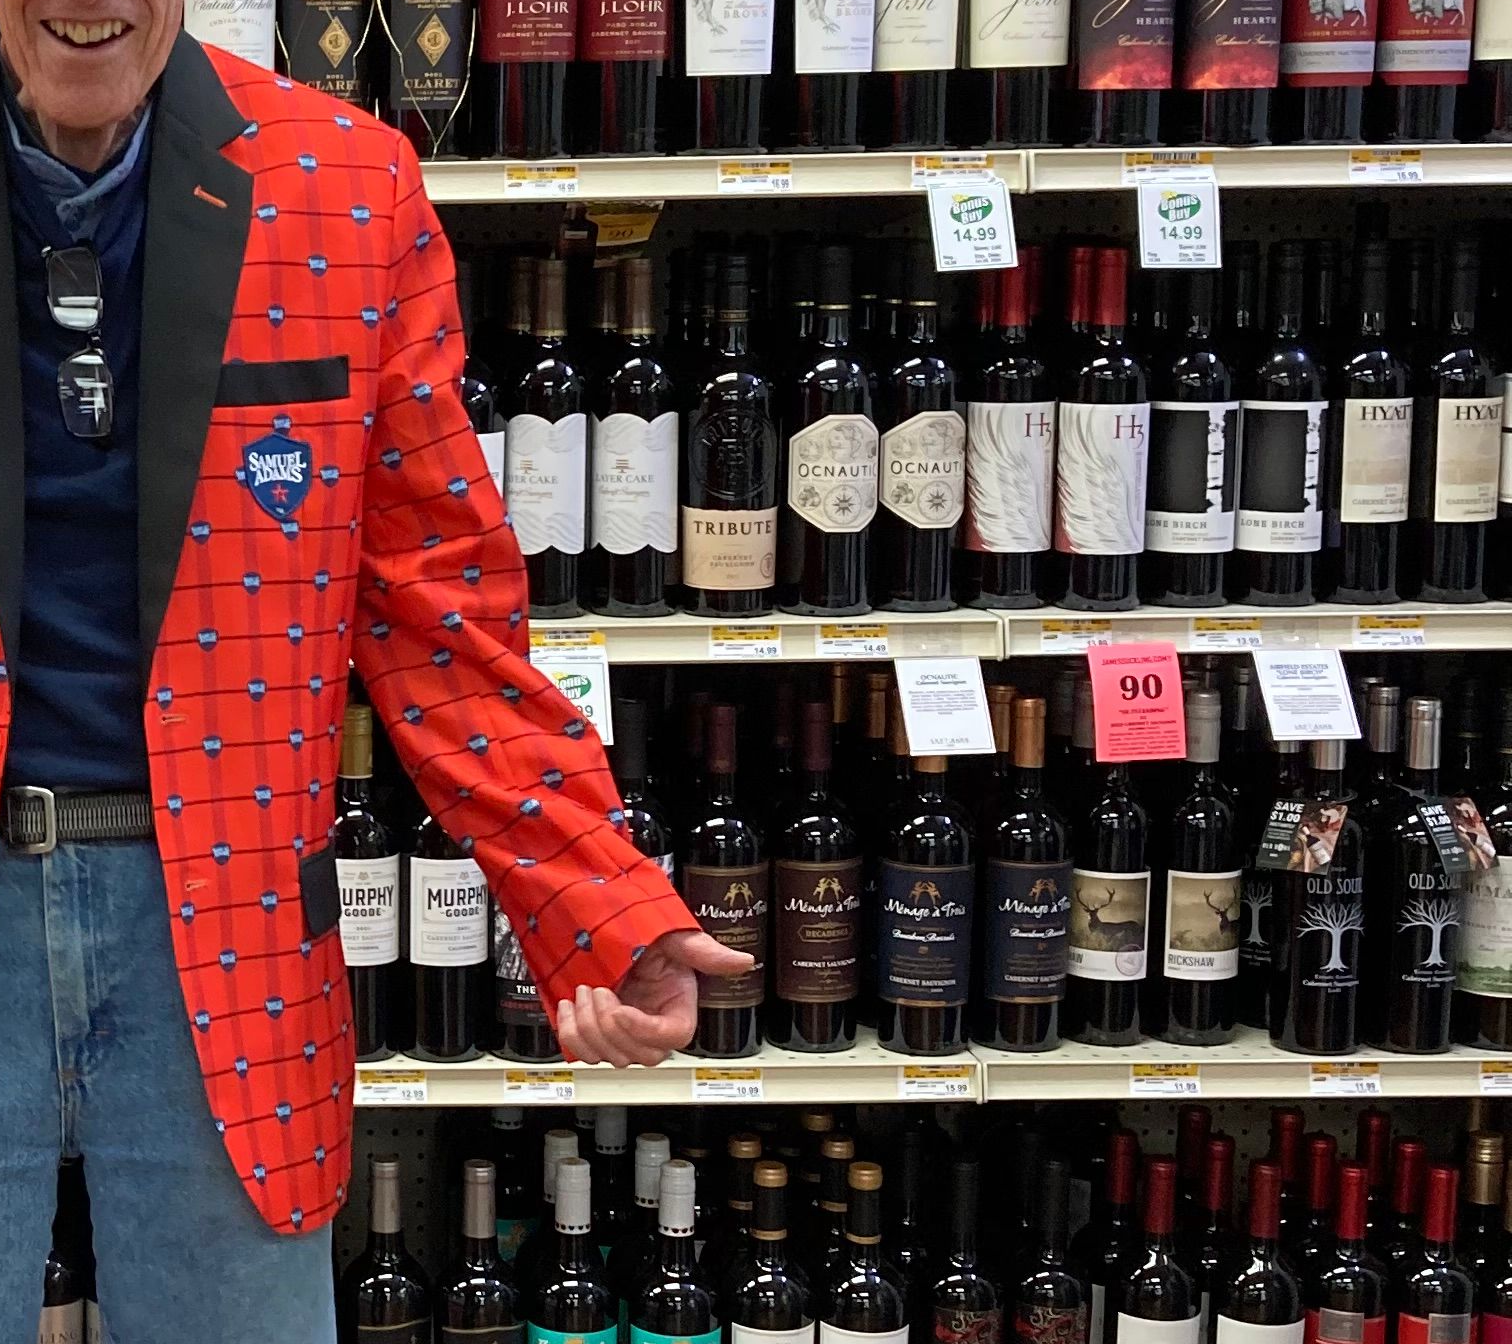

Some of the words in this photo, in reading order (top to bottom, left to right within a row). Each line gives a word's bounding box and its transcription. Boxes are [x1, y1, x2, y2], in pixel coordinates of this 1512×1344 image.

[519, 1, 569, 15] LOHR
[613, 0, 663, 14] LOHR
[724, 8, 768, 20] BROWN
[402, 77, 459, 90] CLARET
[953, 227, 997, 243] 14.99
[1159, 226, 1203, 240] 14.99
[248, 450, 308, 471] SAMUEL
[253, 466, 303, 486] ADAMS
[531, 476, 559, 484] CAKE
[626, 474, 655, 483] CAKE
[693, 521, 773, 536] TRIBUTE
[1145, 518, 1169, 529] LONE
[1172, 520, 1208, 529] BIRCH
[1241, 518, 1269, 528] LONE
[1271, 519, 1305, 528] BIRCH
[864, 644, 887, 652] 14.49
[1236, 637, 1260, 645] 13.99
[753, 646, 778, 655] 14.99
[1120, 673, 1163, 701] 90
[1273, 799, 1305, 814] SAVE
[1420, 803, 1446, 817] SAVE
[1269, 810, 1301, 824] $1.00
[1425, 813, 1452, 827] $1.00
[1307, 877, 1333, 895] OLD
[1336, 876, 1363, 894] SOUL
[1409, 872, 1435, 890] OLD
[339, 884, 394, 908] URPHY
[344, 907, 382, 917] GOODE
[445, 906, 480, 917] GOODE
[694, 903, 744, 923] Ménage
[784, 897, 833, 919] Ménage
[884, 898, 930, 920] Ménage
[941, 902, 966, 917] Trois
[998, 898, 1049, 919] Ménage
[792, 958, 825, 968] CABERNET
[1168, 953, 1215, 967] RICKSHAW
[889, 975, 920, 984] CABERNET
[402, 1089, 424, 1098] 12.99
[737, 1086, 759, 1094] 10.99
[1174, 1082, 1197, 1091] 11.99
[1355, 1082, 1376, 1091] 11.99
